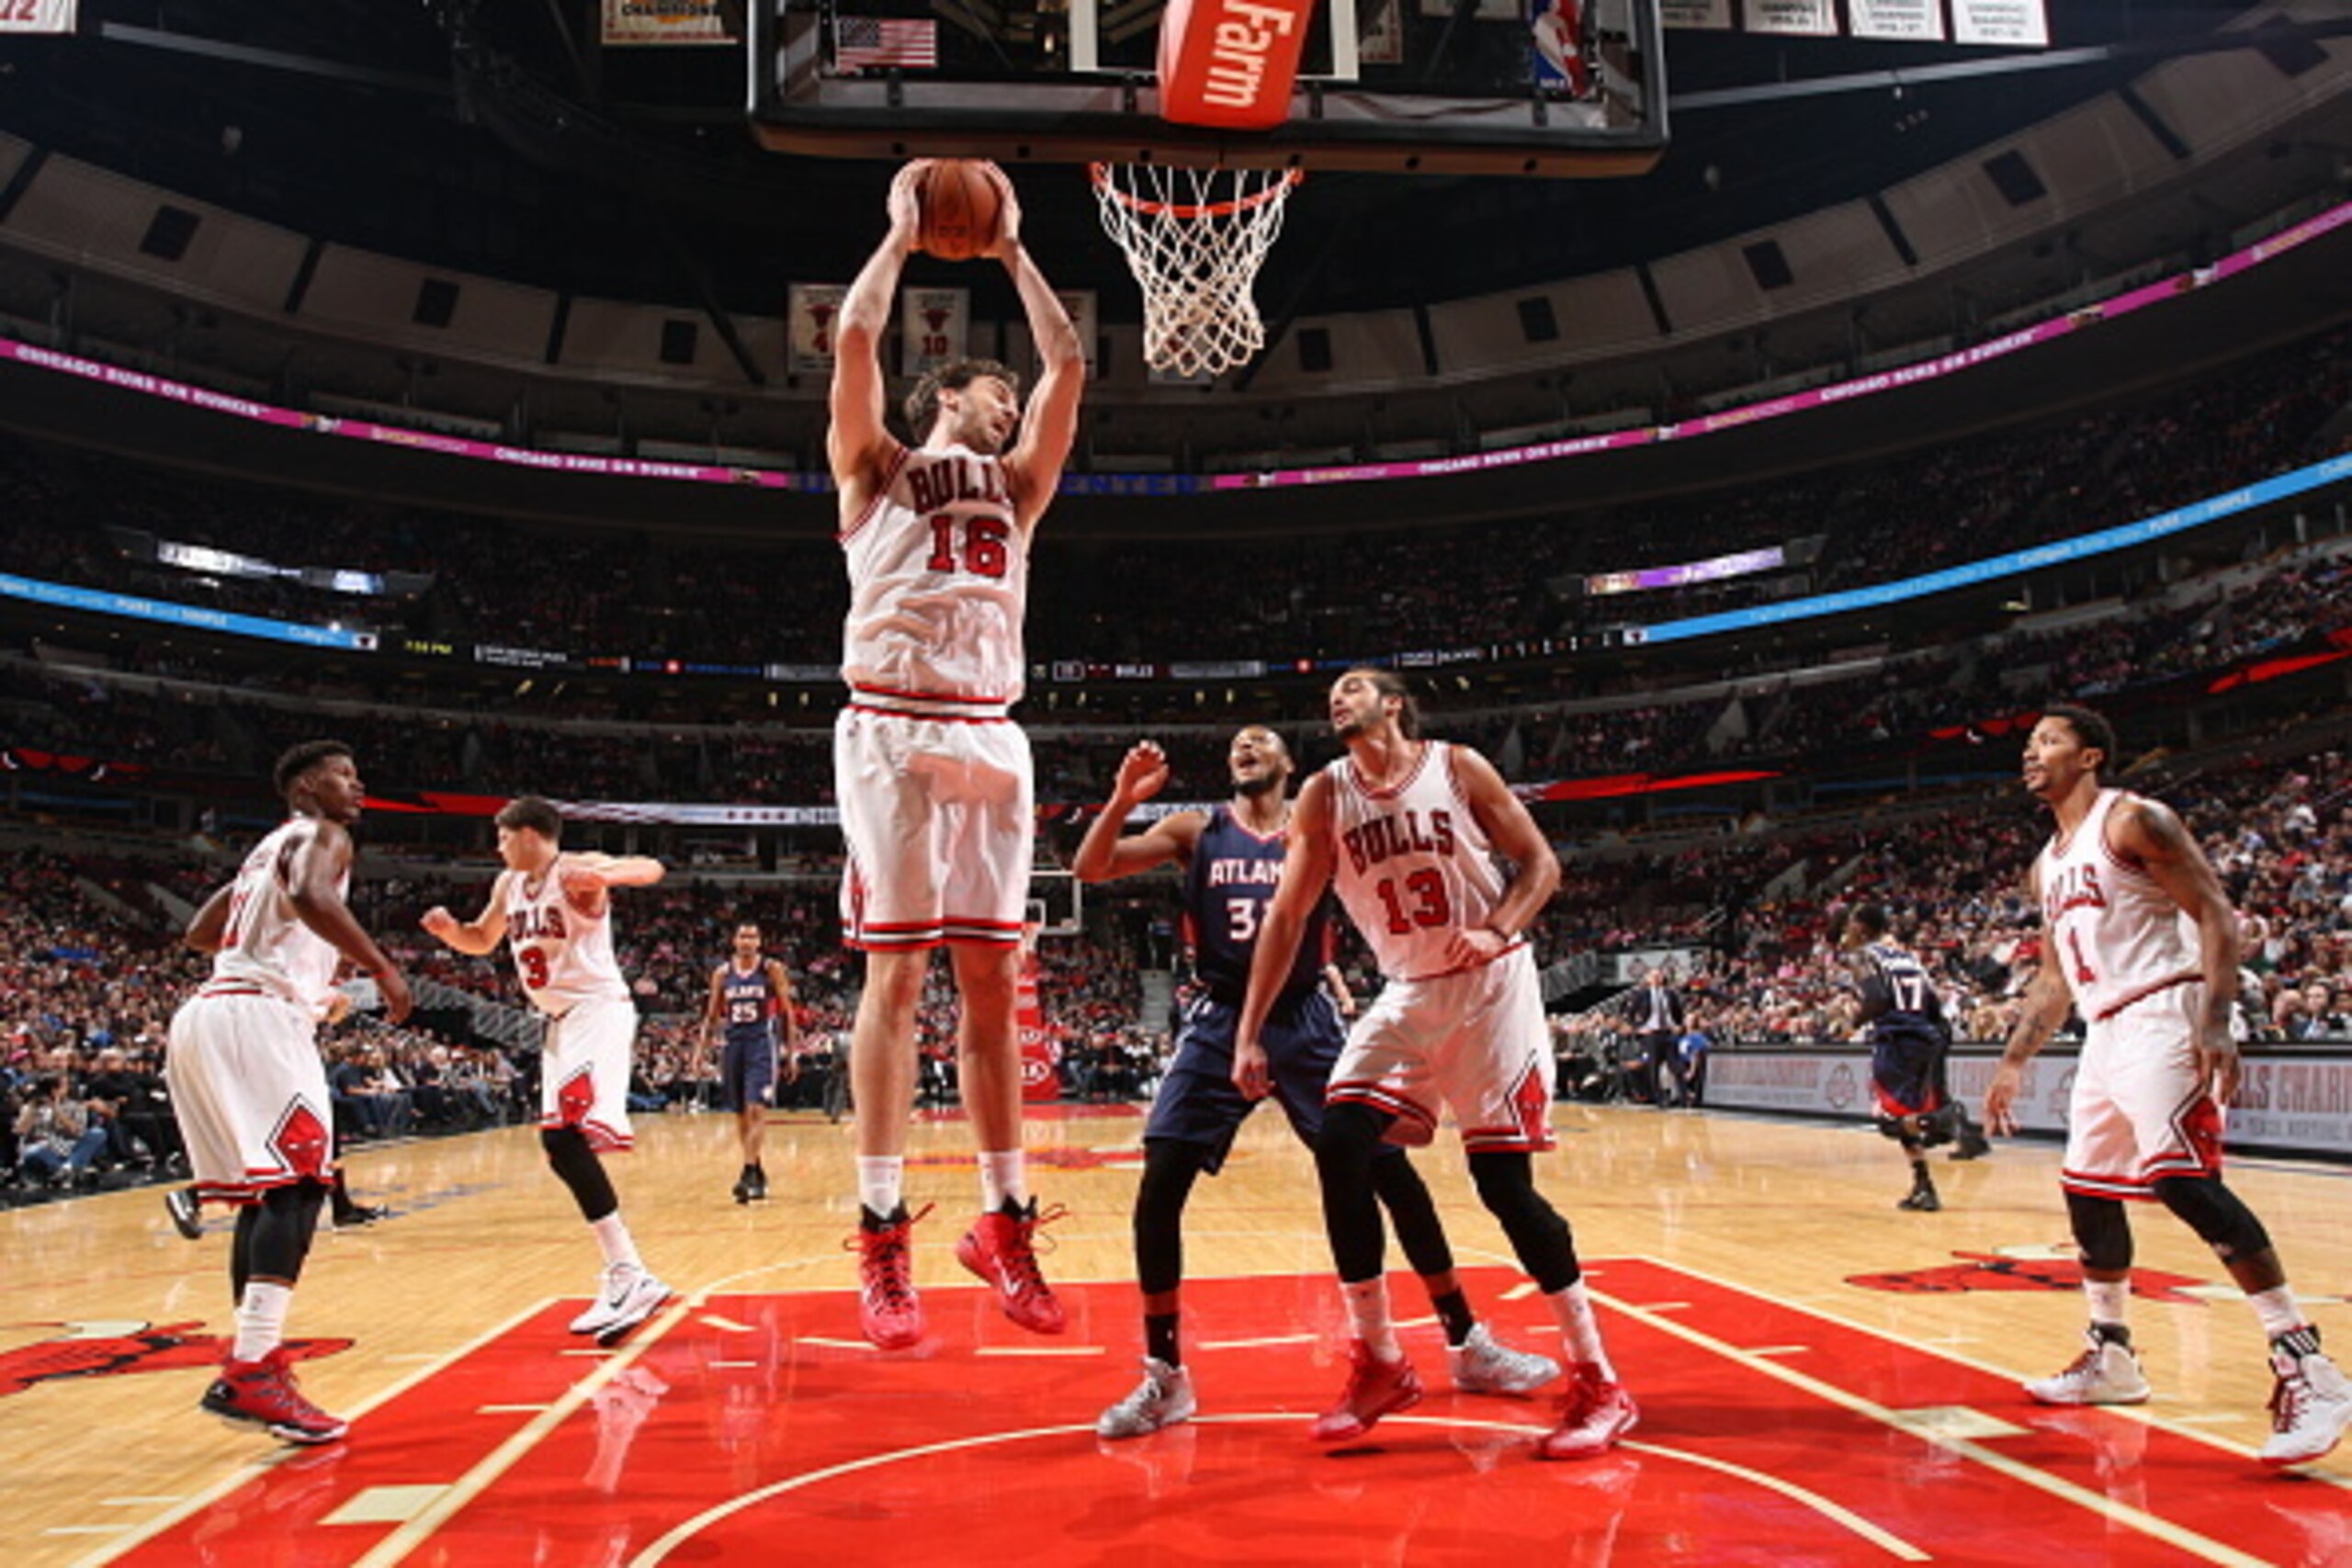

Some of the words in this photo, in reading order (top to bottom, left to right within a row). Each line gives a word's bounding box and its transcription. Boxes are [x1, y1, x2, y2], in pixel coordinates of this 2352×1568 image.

[1203, 0, 1296, 108] Farm
[922, 335, 947, 355] 10
[907, 457, 1010, 515] BULL
[1060, 473, 1197, 497] ENTER
[927, 514, 1010, 578] 16
[1342, 808, 1453, 877] BULLS
[1208, 858, 1286, 886] ATLAN
[2047, 864, 2107, 920] ULLS
[506, 906, 566, 942] ULLS
[1227, 897, 1273, 941] 3
[1376, 868, 1450, 935] 13
[518, 946, 548, 990] 3
[2068, 927, 2096, 986] 1
[732, 1002, 758, 1022] 25
[1893, 975, 1922, 1011] 17
[2277, 1064, 2352, 1114] CHARI
